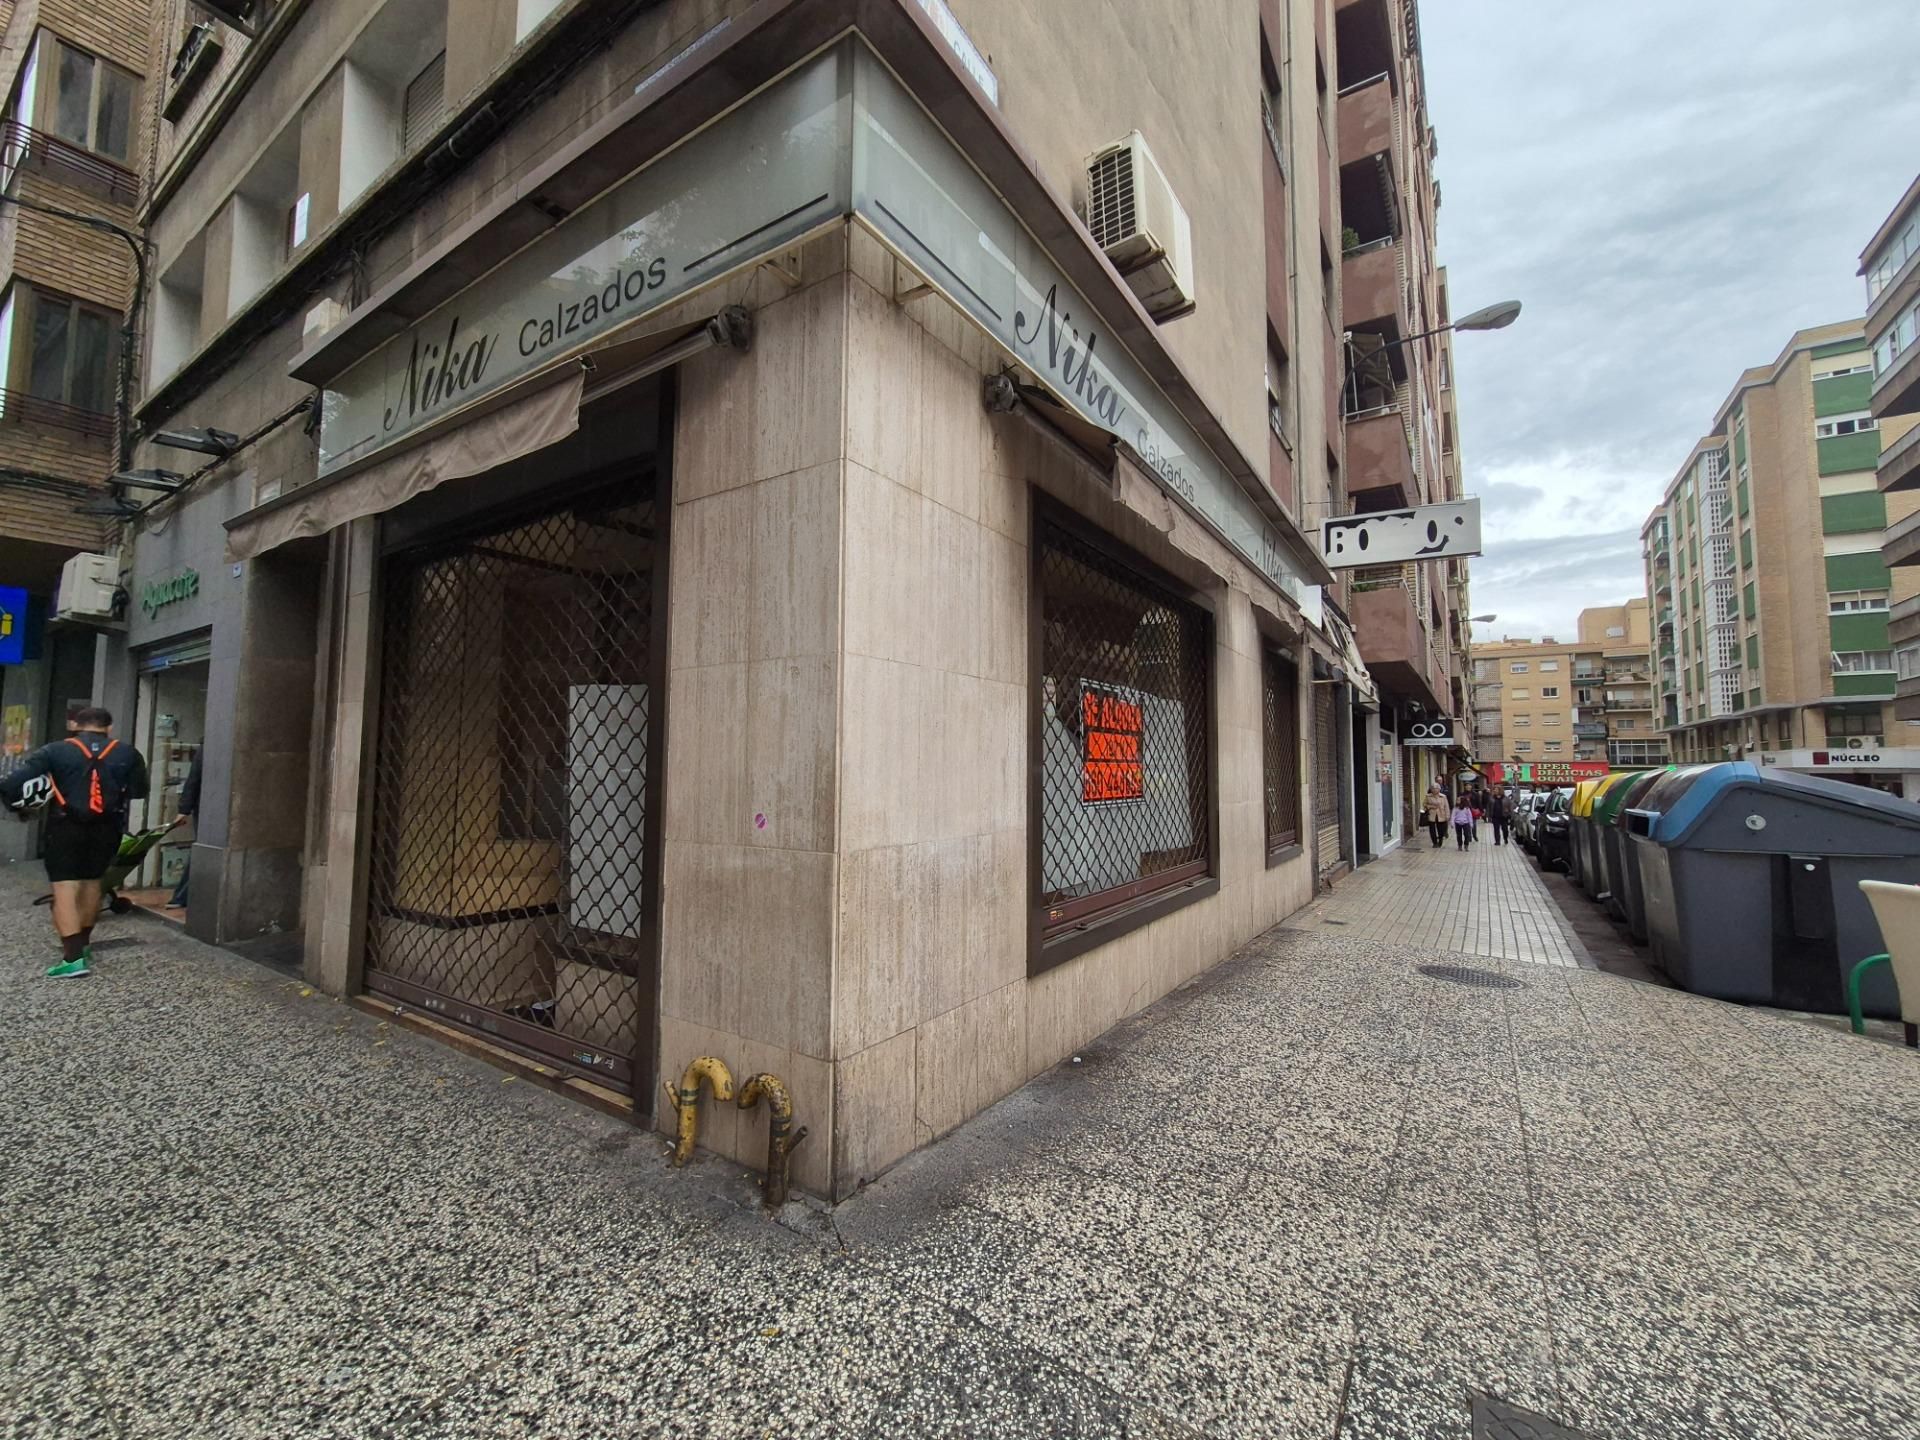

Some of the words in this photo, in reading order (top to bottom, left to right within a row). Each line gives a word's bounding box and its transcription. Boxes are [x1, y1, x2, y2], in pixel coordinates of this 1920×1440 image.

[383, 316, 499, 431] Nika
[518, 257, 667, 357] Calzados
[1014, 284, 1126, 427] Nika
[1137, 428, 1195, 502] Calzados
[1831, 752, 1880, 762] NÚCLEO
